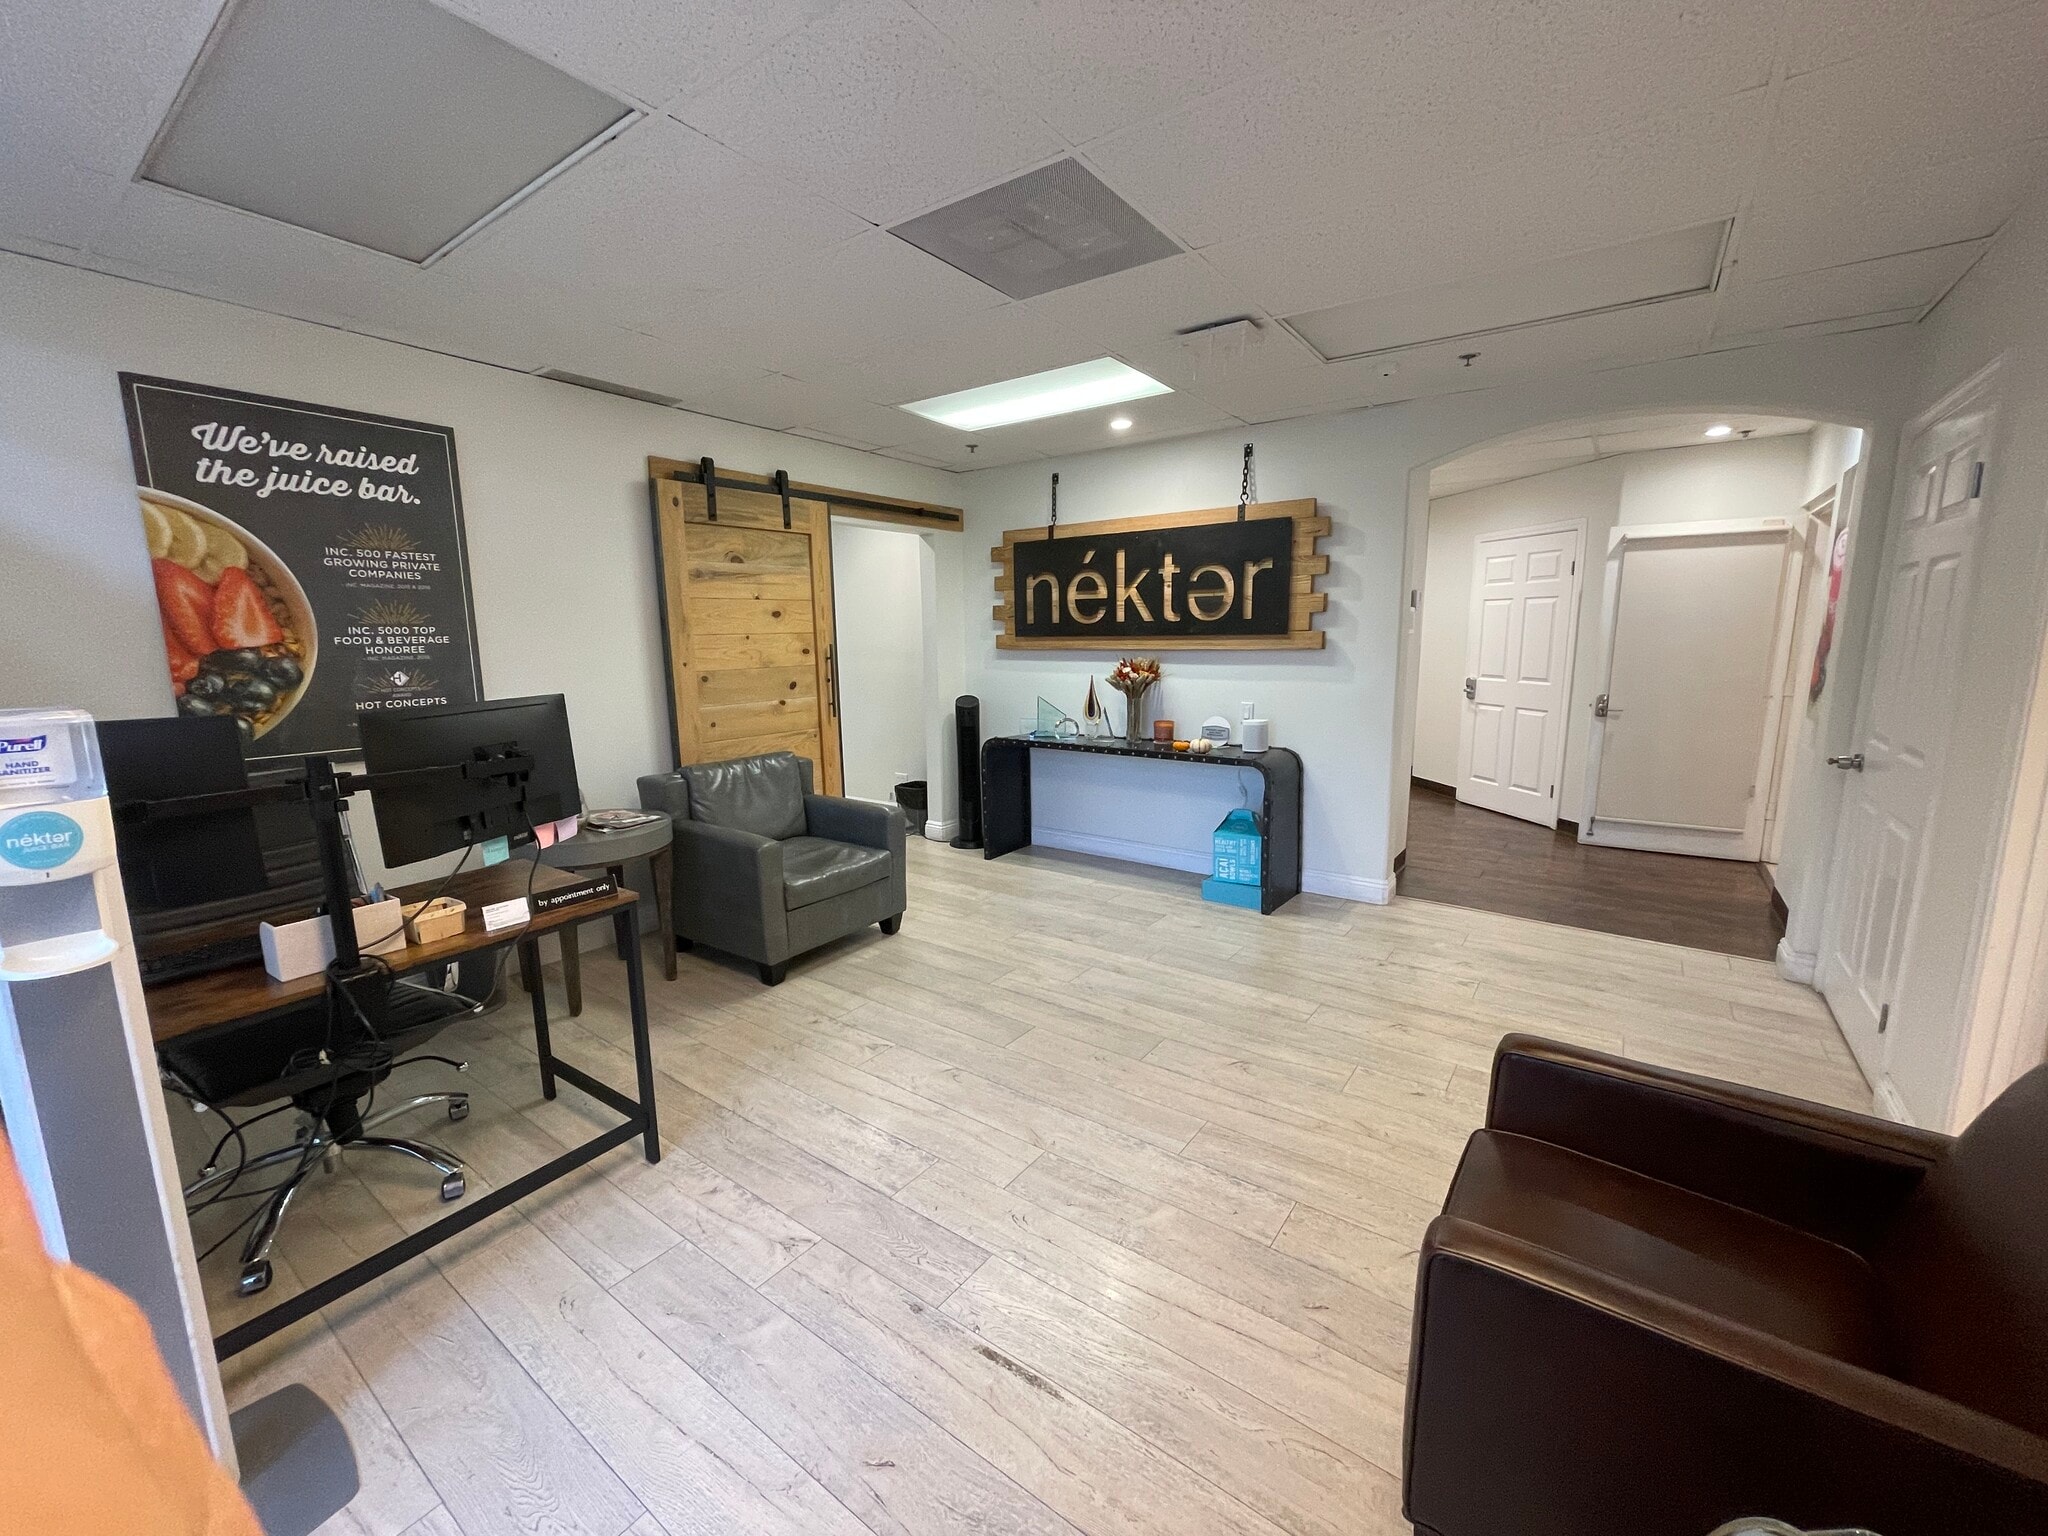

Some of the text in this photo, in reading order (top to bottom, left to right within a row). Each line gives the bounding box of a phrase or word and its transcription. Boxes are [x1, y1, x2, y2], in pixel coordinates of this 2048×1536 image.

[191, 421, 420, 475] We've raised
[195, 457, 421, 505] the juice bar.
[325, 546, 436, 561] INC. 500 FASTEST
[323, 557, 441, 572] GROWING PRIVATE
[348, 569, 421, 580] COMPANIES
[347, 626, 436, 635] INC. 5000 TOP
[334, 635, 451, 645] FOOD & BEVERAGE
[365, 645, 426, 655] HONOREE
[355, 697, 448, 710] HOT CONCEPTS
[5, 760, 39, 769] HAND
[538, 883, 610, 907] by appointment only
